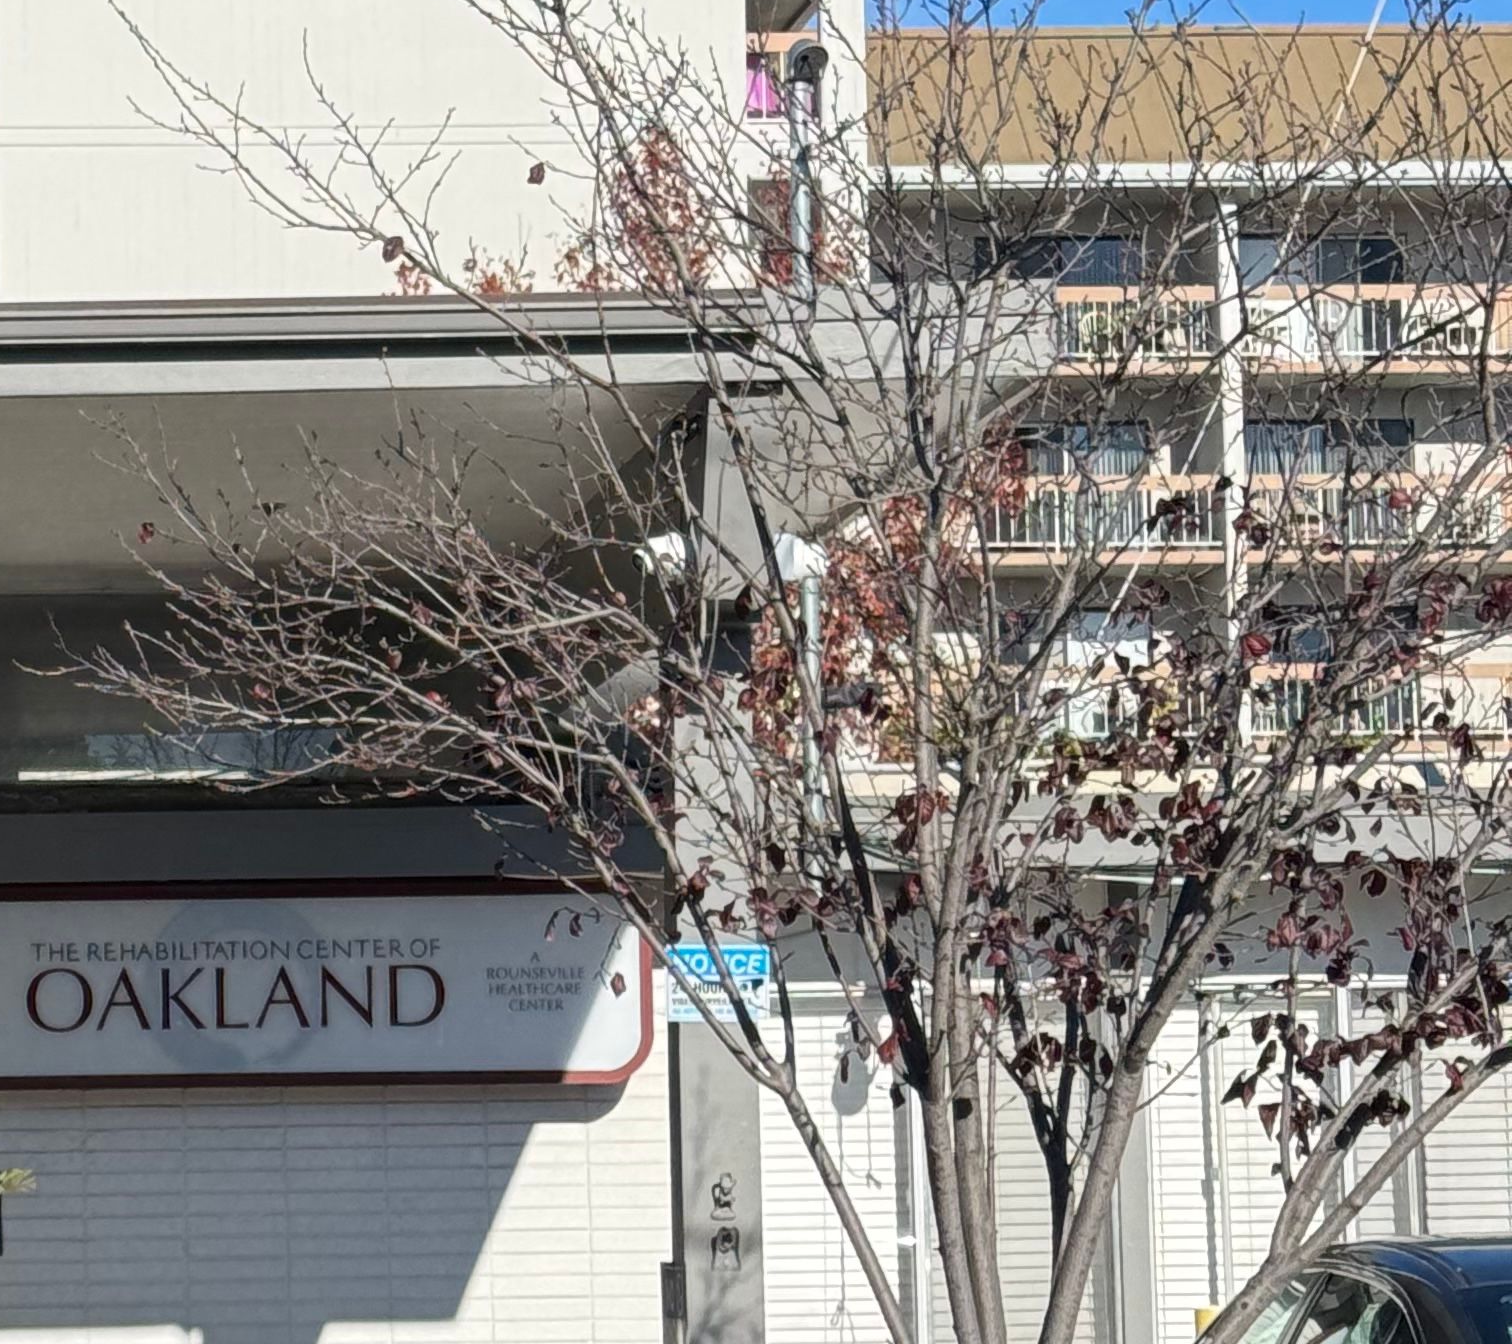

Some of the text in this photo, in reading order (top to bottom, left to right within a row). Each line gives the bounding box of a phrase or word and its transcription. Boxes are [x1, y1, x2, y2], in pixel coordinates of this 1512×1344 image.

[31, 938, 441, 962] THE REHABILITATION CENTER OF
[530, 951, 541, 963] A
[671, 952, 764, 975] NOCE
[486, 966, 585, 981] ROUNSEVILLE
[487, 982, 582, 996] HEALTHCARE
[25, 964, 446, 1033] OAKLAND
[508, 998, 565, 1012] CENTER
